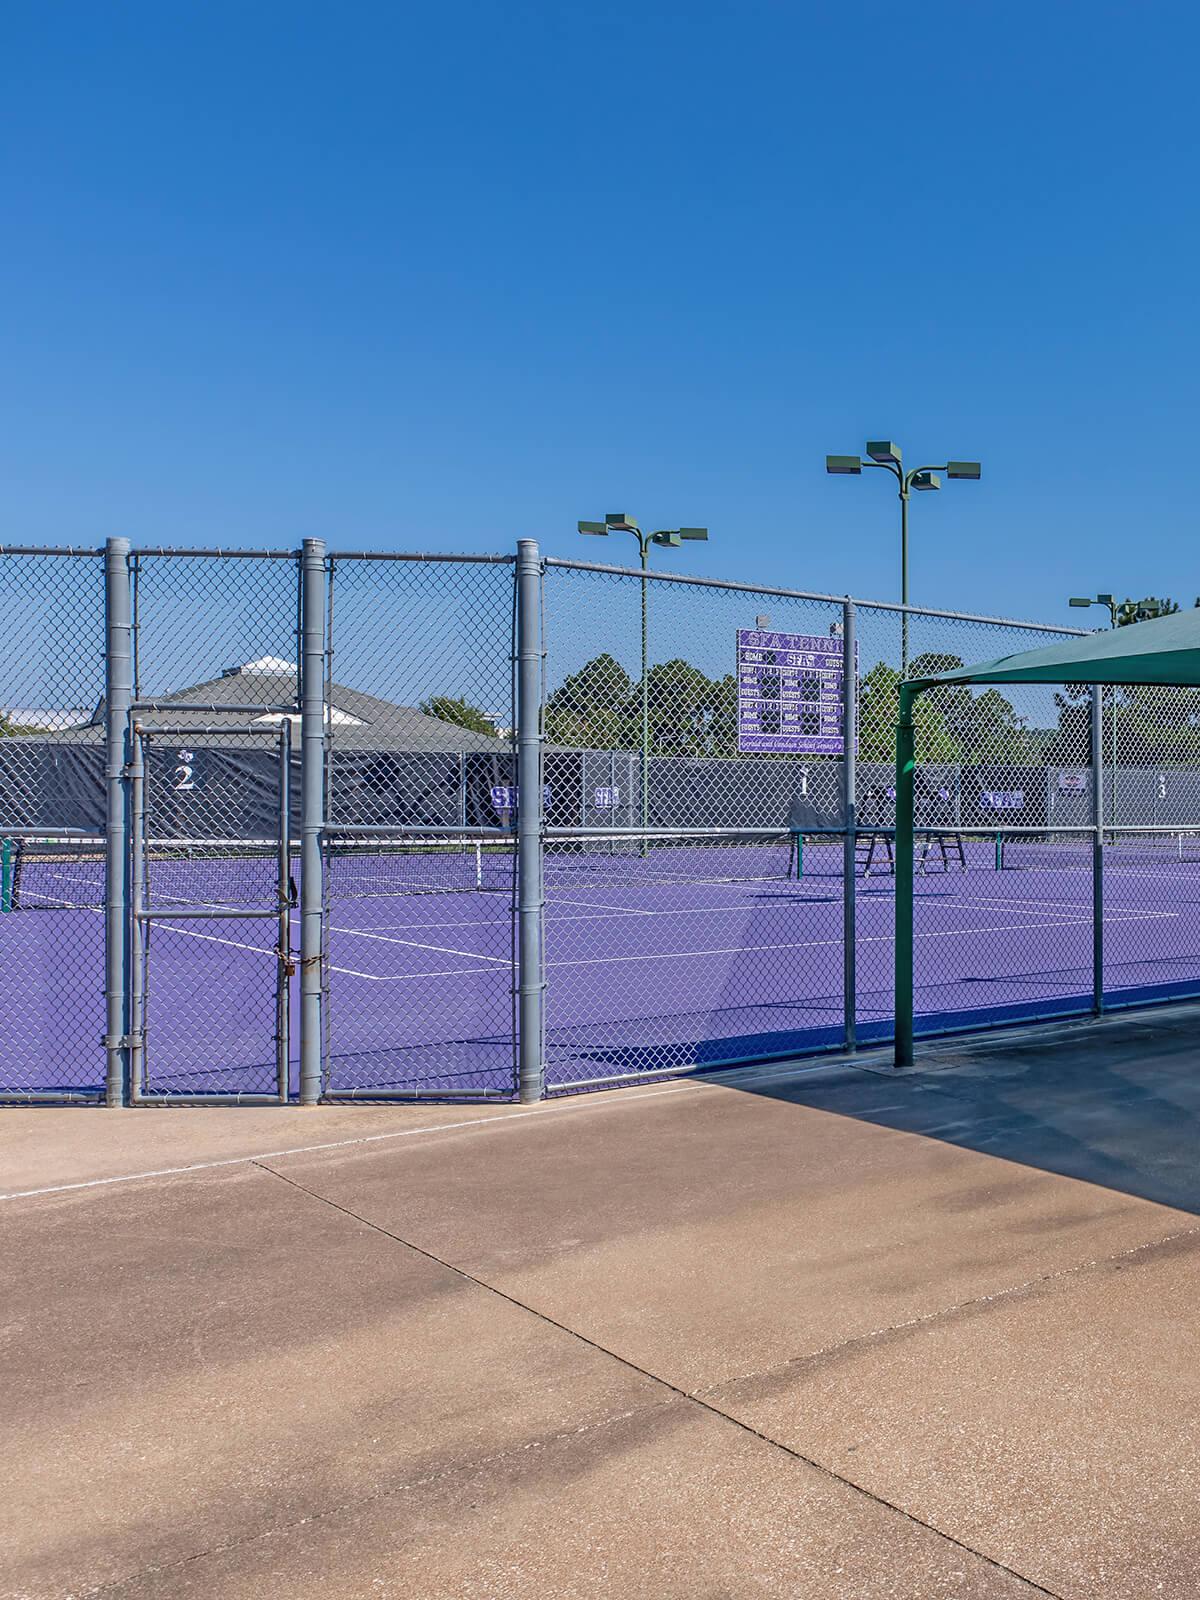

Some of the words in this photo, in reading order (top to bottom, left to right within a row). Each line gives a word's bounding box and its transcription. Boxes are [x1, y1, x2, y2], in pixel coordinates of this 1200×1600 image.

[748, 632, 781, 649] SFA
[785, 636, 844, 654] TENNI
[175, 765, 194, 790] 2
[1158, 784, 1166, 798] 3
